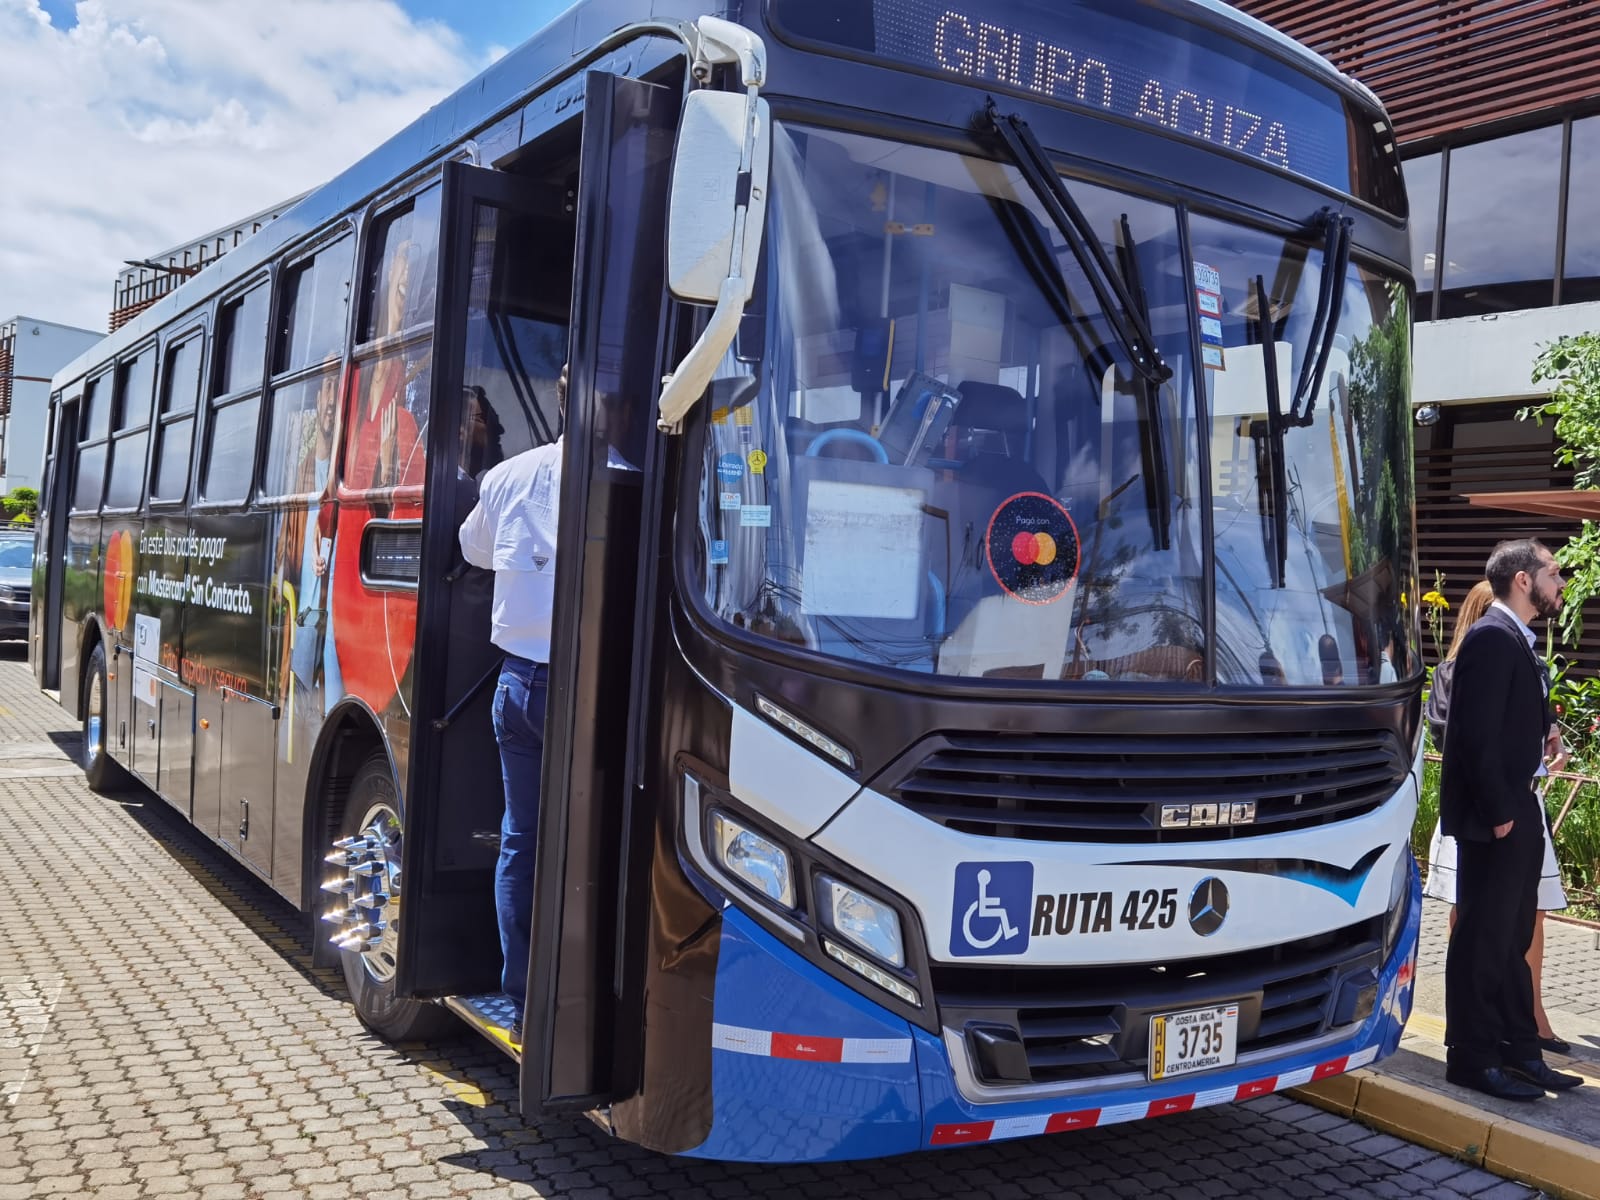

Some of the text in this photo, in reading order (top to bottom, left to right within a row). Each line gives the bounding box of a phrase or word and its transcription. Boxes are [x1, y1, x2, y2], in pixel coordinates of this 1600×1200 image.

[934, 10, 1113, 107] GRUPO
[1036, 517, 1050, 525] con
[139, 530, 147, 554] En
[148, 532, 164, 554] este
[163, 533, 176, 556] bus
[199, 537, 227, 567] pagar
[137, 575, 148, 594] con
[191, 574, 204, 605] Sin
[205, 576, 253, 615] Contacto.
[1031, 888, 1178, 936] RUTA 425
[1175, 1012, 1215, 1026] COSTA RICA
[1178, 1021, 1223, 1059] 3735
[1166, 1055, 1221, 1074] CENTROAMERICA
